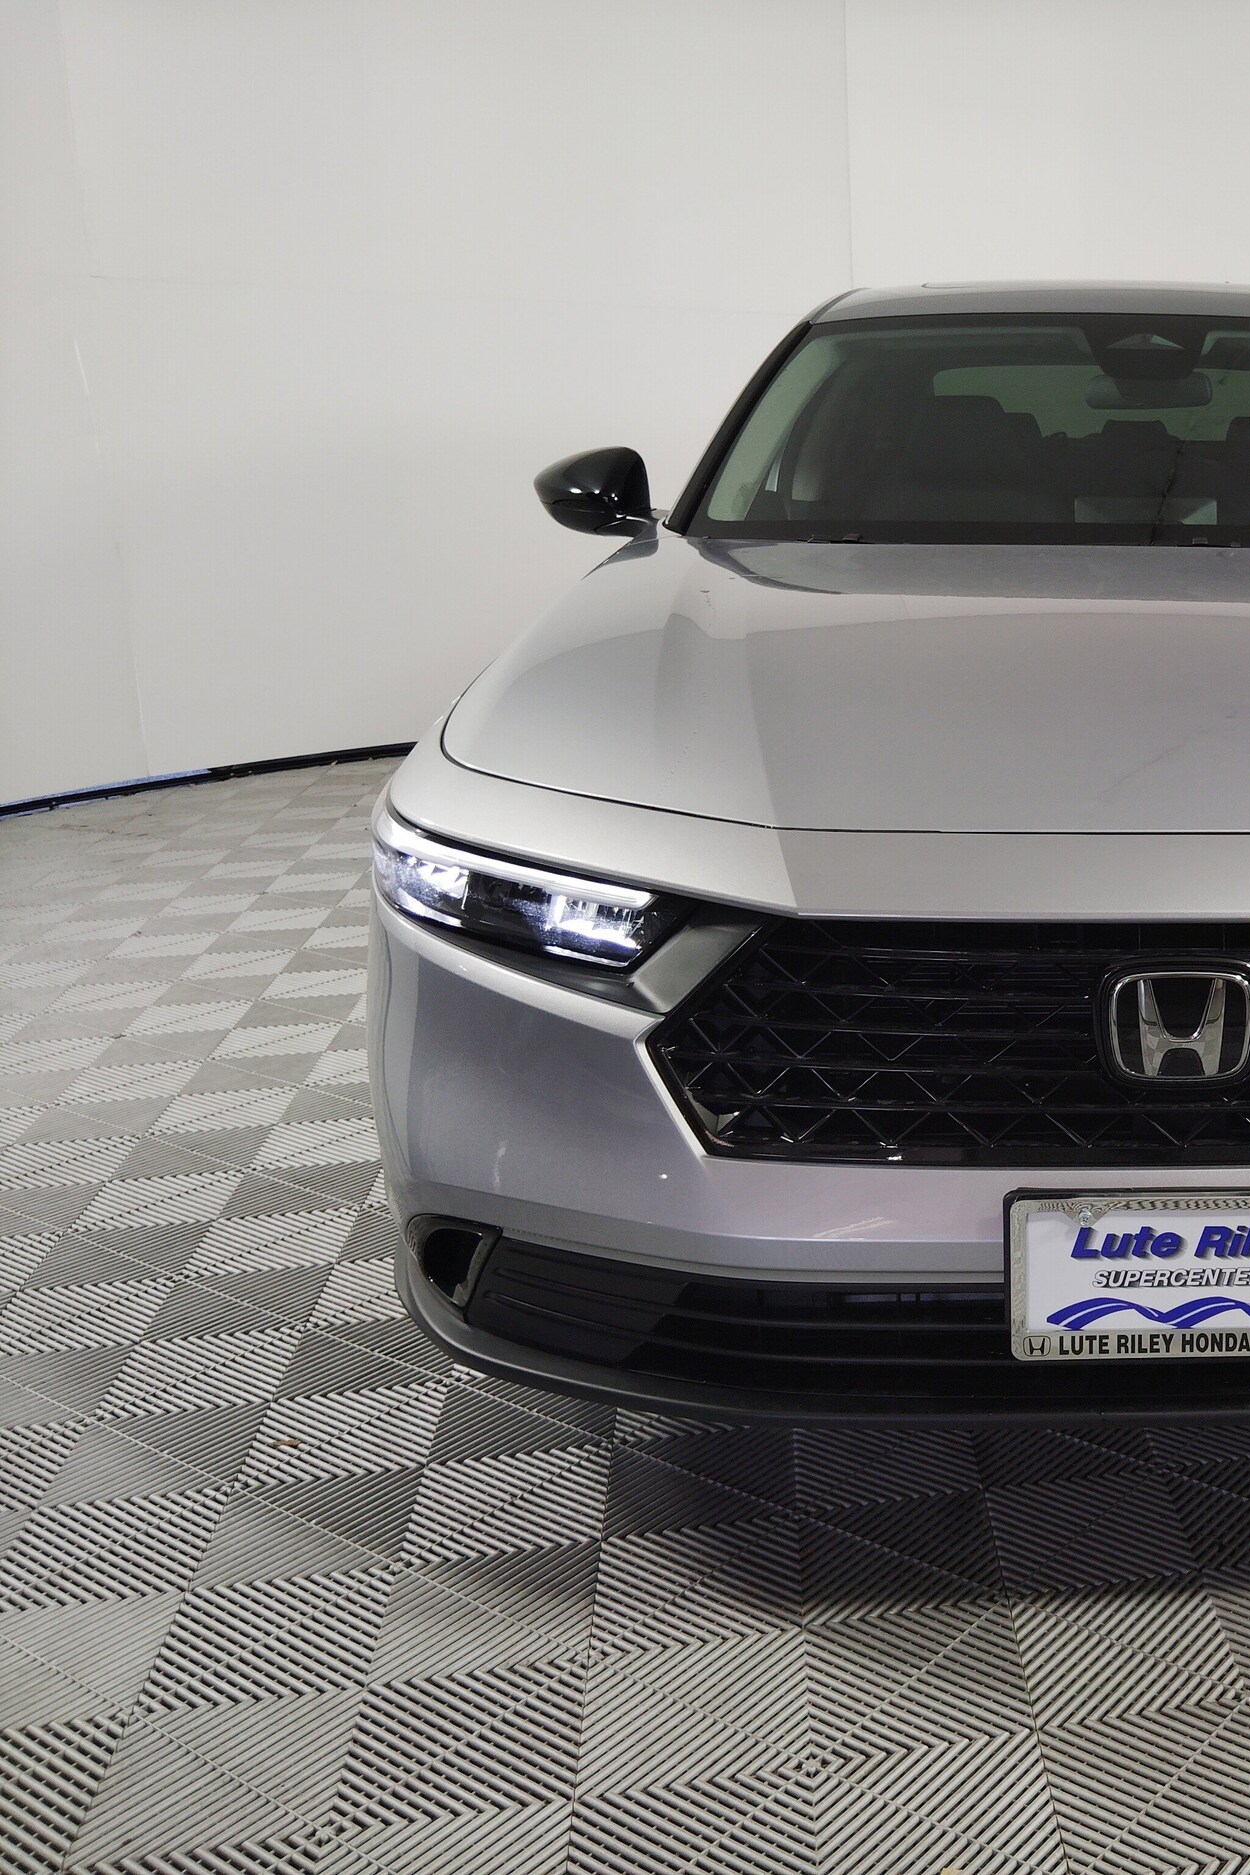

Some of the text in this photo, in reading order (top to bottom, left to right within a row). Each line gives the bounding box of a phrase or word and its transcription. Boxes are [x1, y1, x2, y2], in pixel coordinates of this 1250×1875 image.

[1071, 1226, 1182, 1259] Lute
[1059, 1335, 1110, 1355] LUTE
[1117, 1334, 1173, 1354] RILEY
[1181, 1333, 1250, 1353] HONDA
